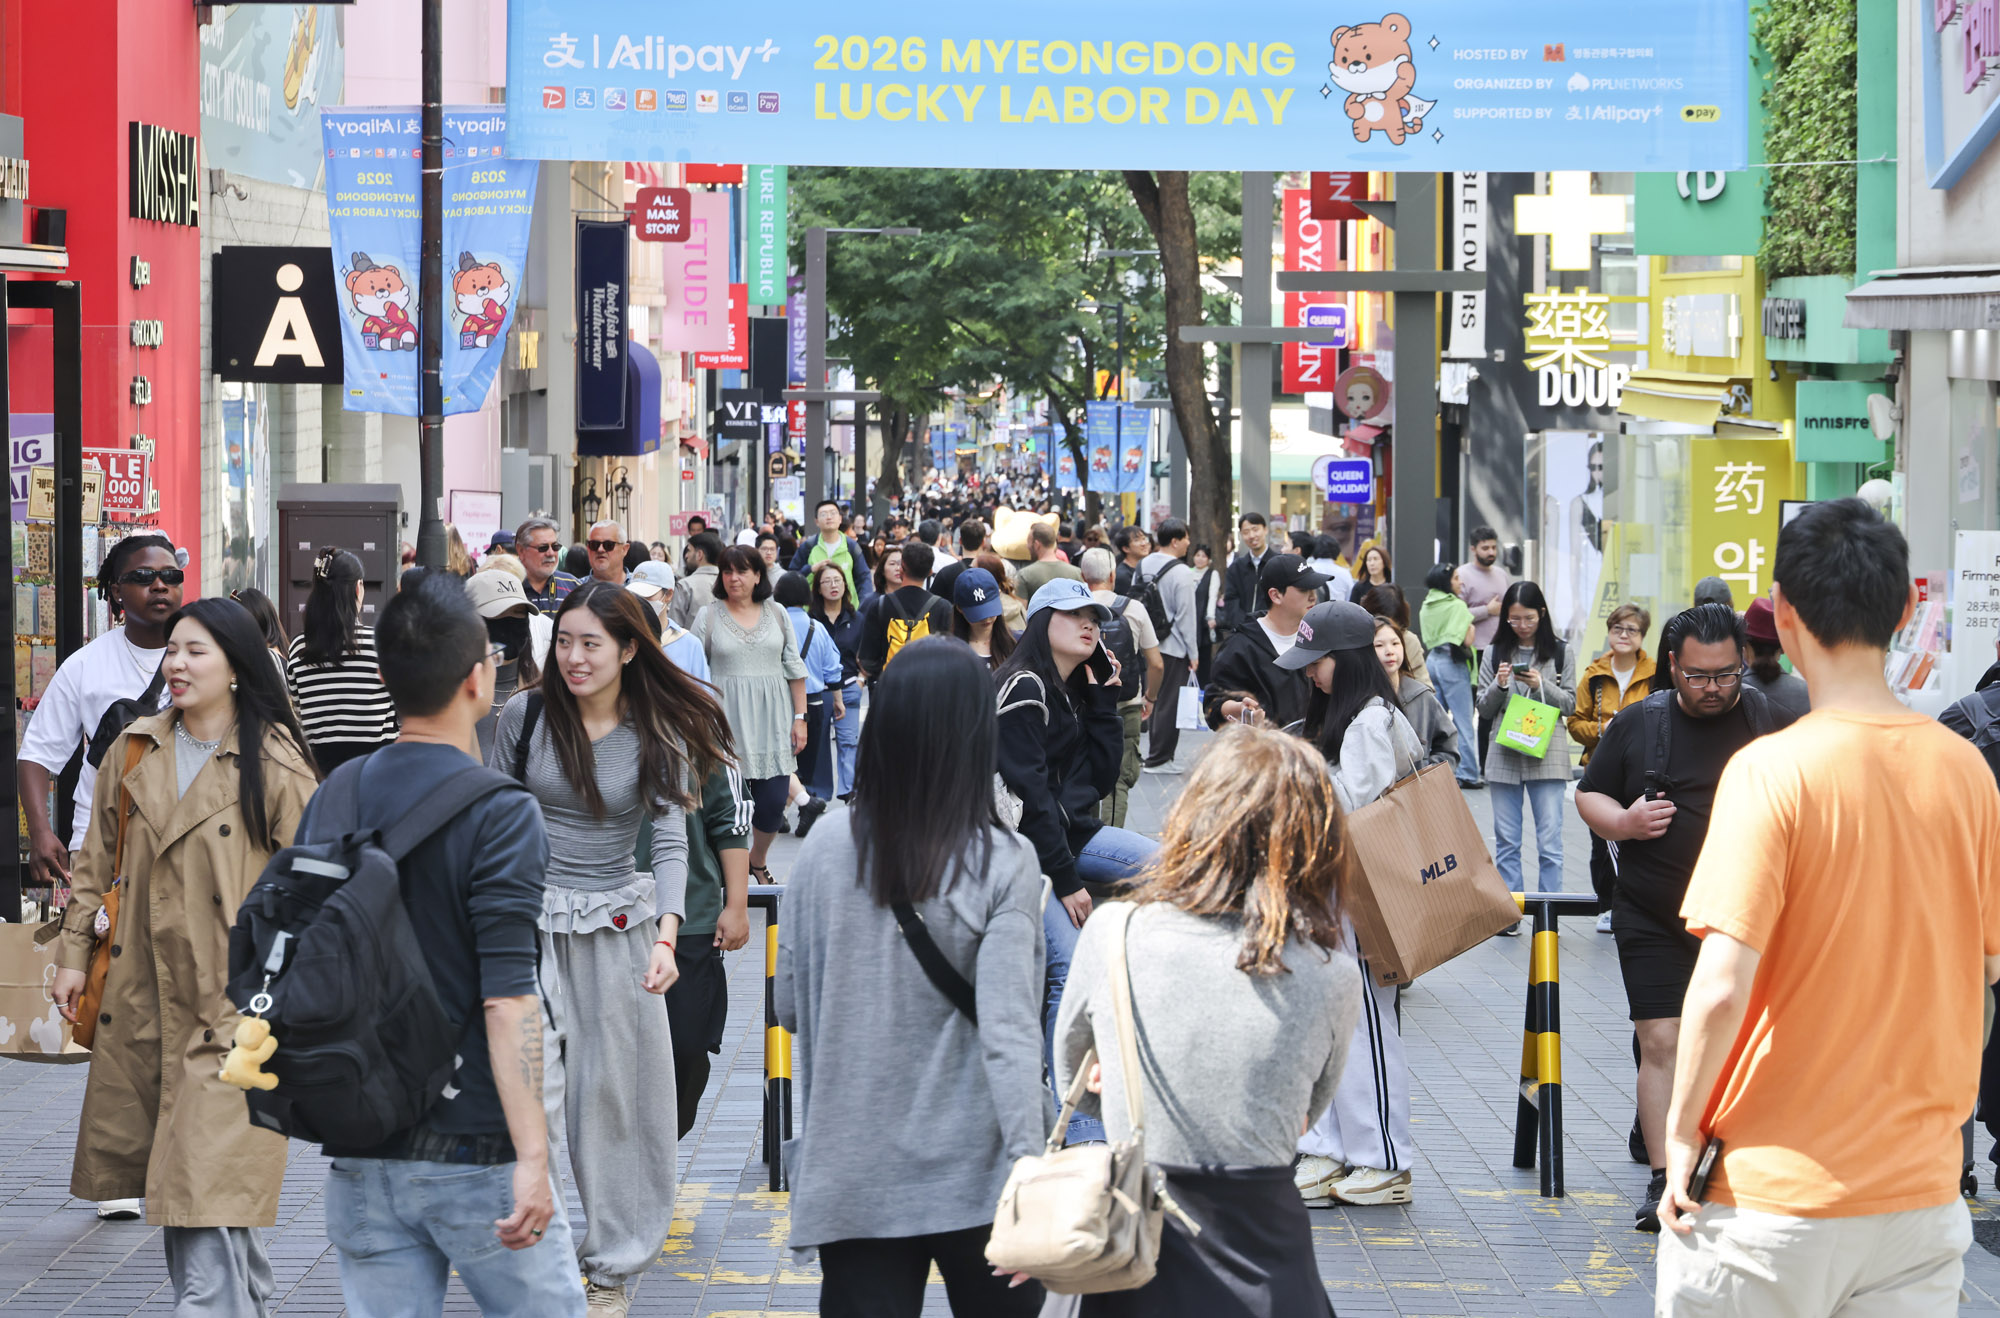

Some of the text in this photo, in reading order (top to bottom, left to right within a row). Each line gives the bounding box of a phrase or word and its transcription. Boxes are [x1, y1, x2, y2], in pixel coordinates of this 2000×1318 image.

[814, 35, 1296, 76] 2026 MYEONGDONG
[1454, 49, 1528, 60] HOSTED BY
[1454, 78, 1553, 89] ORGANIZED BY
[760, 99, 777, 111] Pay
[814, 83, 1296, 125] LUCKY LABOR DAY
[1454, 108, 1553, 119] SUPPORTED BY
[1697, 109, 1715, 119] pay
[138, 121, 200, 228] MISSHA
[653, 195, 674, 206] ALL
[647, 209, 679, 221] MASK
[645, 223, 680, 235] STORY
[760, 210, 774, 297] REPUBLIC
[684, 218, 707, 325] ETUDE
[1461, 223, 1477, 329] LOVRS
[604, 281, 620, 338] Rockfish
[1310, 315, 1341, 326] QUEEN
[1524, 286, 1611, 374] 藥
[700, 354, 743, 364] Drug Store
[725, 401, 758, 419] VT
[1331, 471, 1364, 482] QUEEN
[1328, 483, 1370, 494] HOLIDAY
[1714, 461, 1766, 515] 药
[1713, 538, 1765, 595] 약
[1420, 853, 1458, 885] MLB
[1383, 971, 1398, 981] MLB
